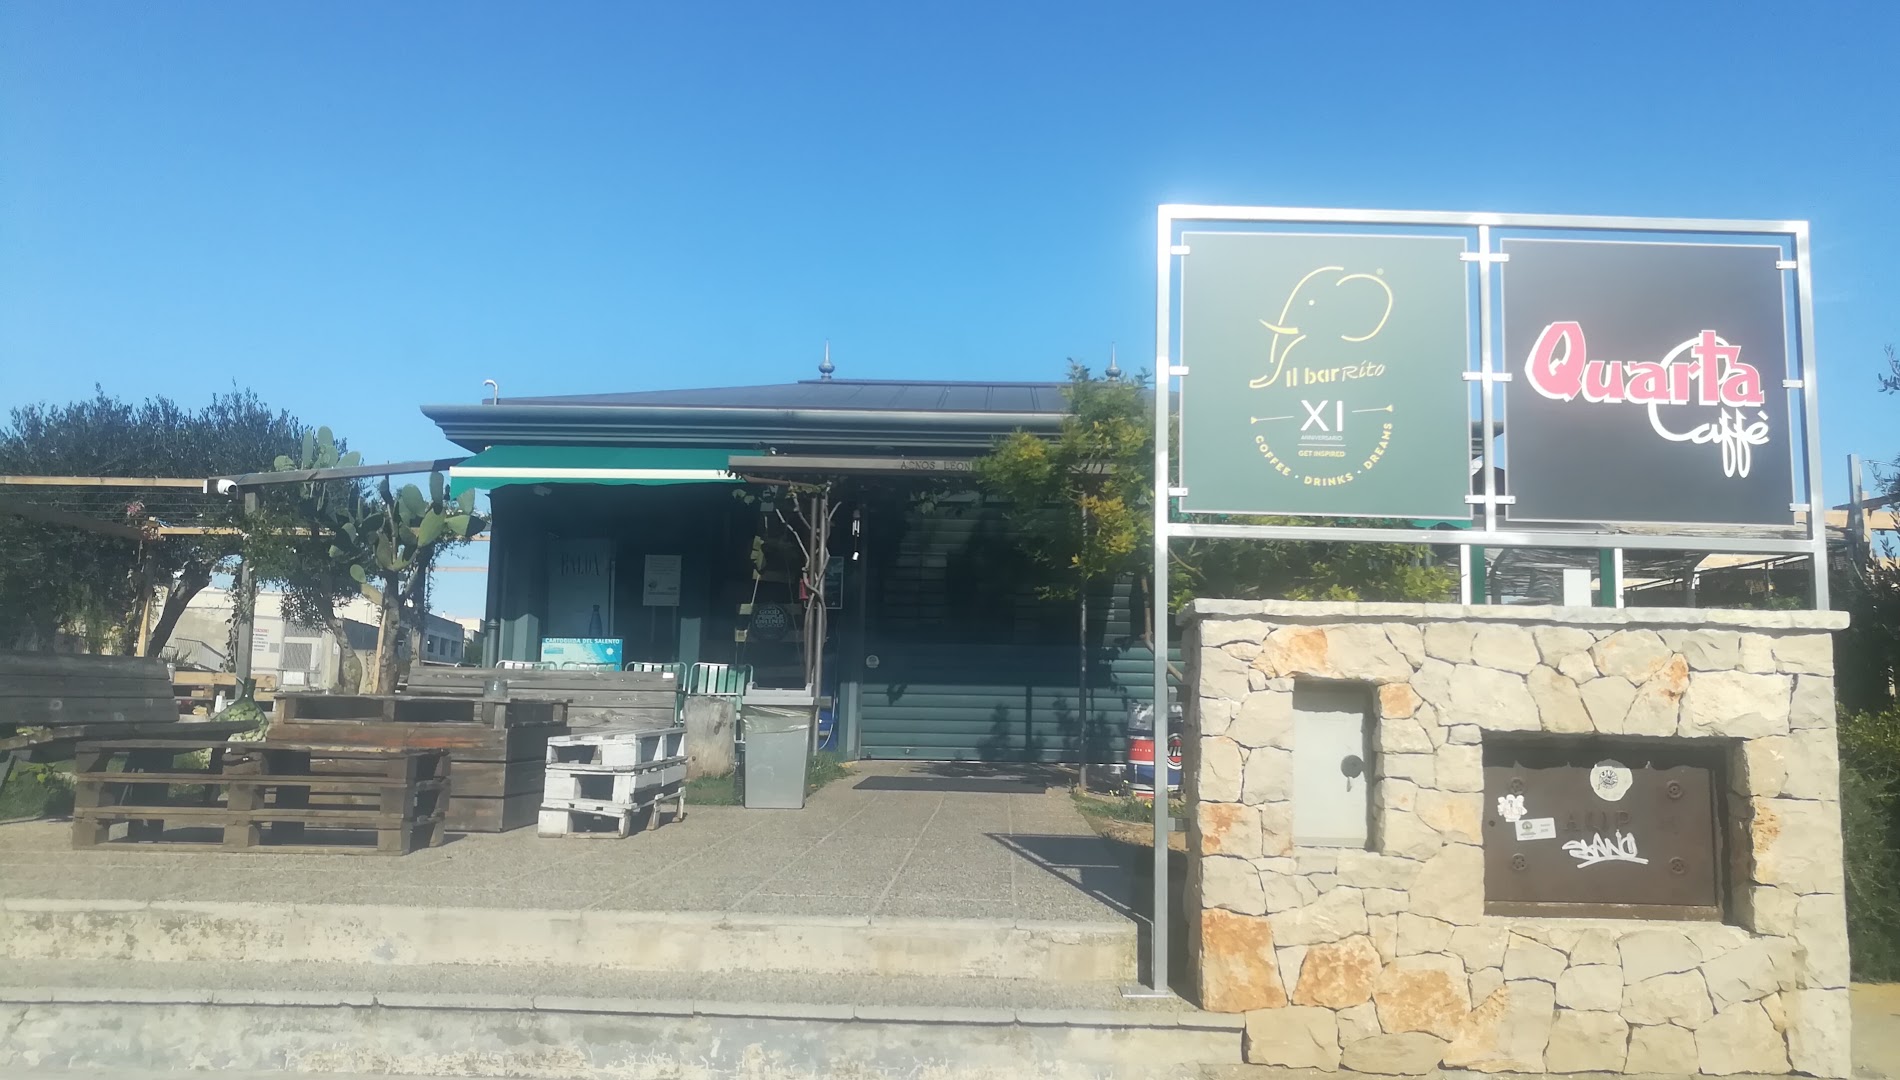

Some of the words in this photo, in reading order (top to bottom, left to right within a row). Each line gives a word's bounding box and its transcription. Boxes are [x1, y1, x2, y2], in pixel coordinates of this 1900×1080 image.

[1286, 367, 1298, 387] Il
[1524, 321, 1765, 406] Quarta
[1300, 399, 1344, 432] XI
[1255, 435, 1292, 477] COFFEE
[1303, 472, 1354, 487] DRINKS
[1363, 422, 1393, 470] DREAMS
[1298, 450, 1313, 458] GET
[1313, 450, 1346, 458] INSPIRED
